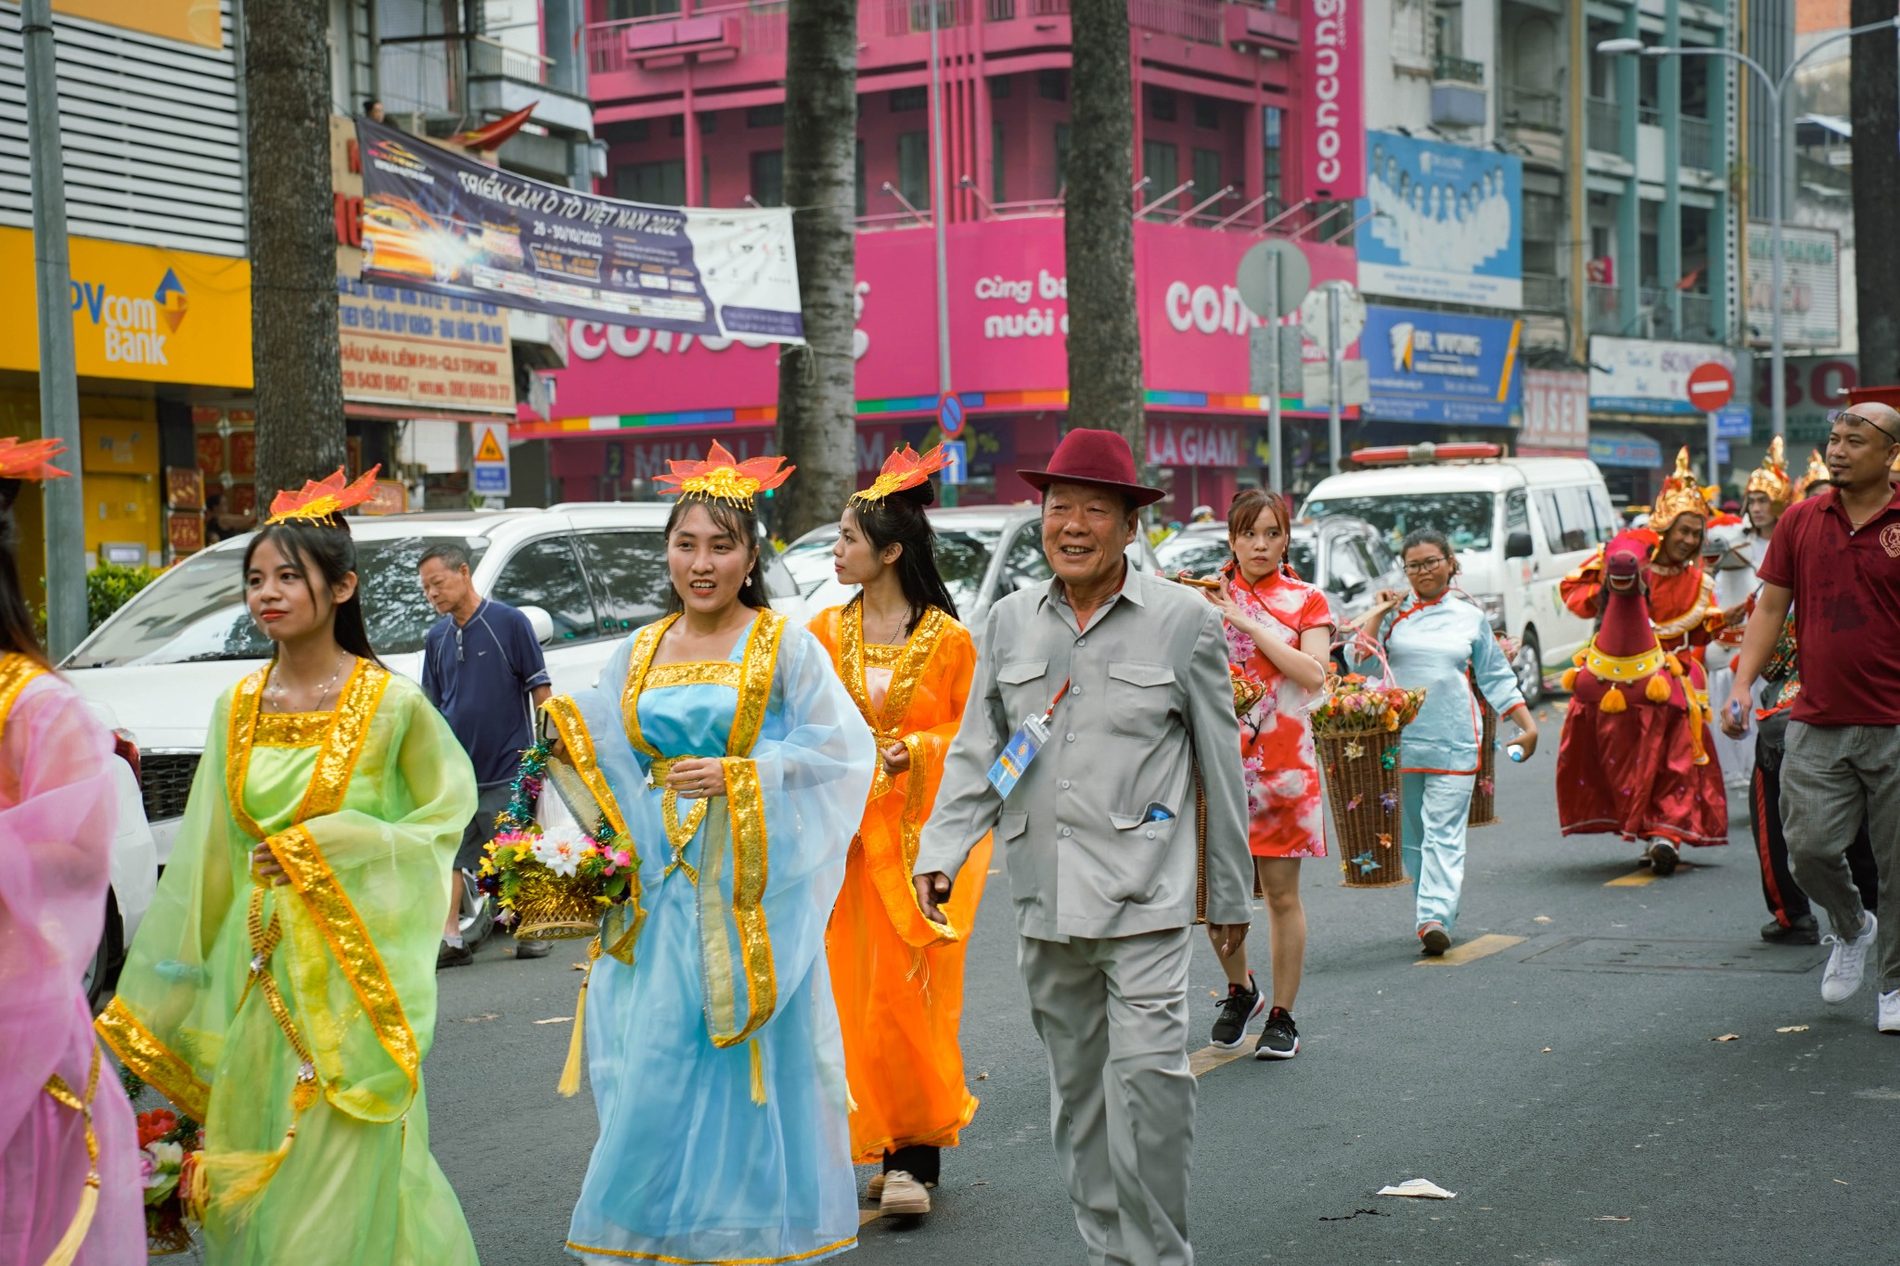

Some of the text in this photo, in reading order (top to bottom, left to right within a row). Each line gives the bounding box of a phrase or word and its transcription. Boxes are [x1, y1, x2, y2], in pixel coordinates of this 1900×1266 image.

[613, 209, 650, 232] NAM
[645, 214, 682, 236] 2022
[975, 274, 1033, 304] Cùng
[984, 307, 1054, 339] nuôi
[104, 326, 168, 366] Bank
